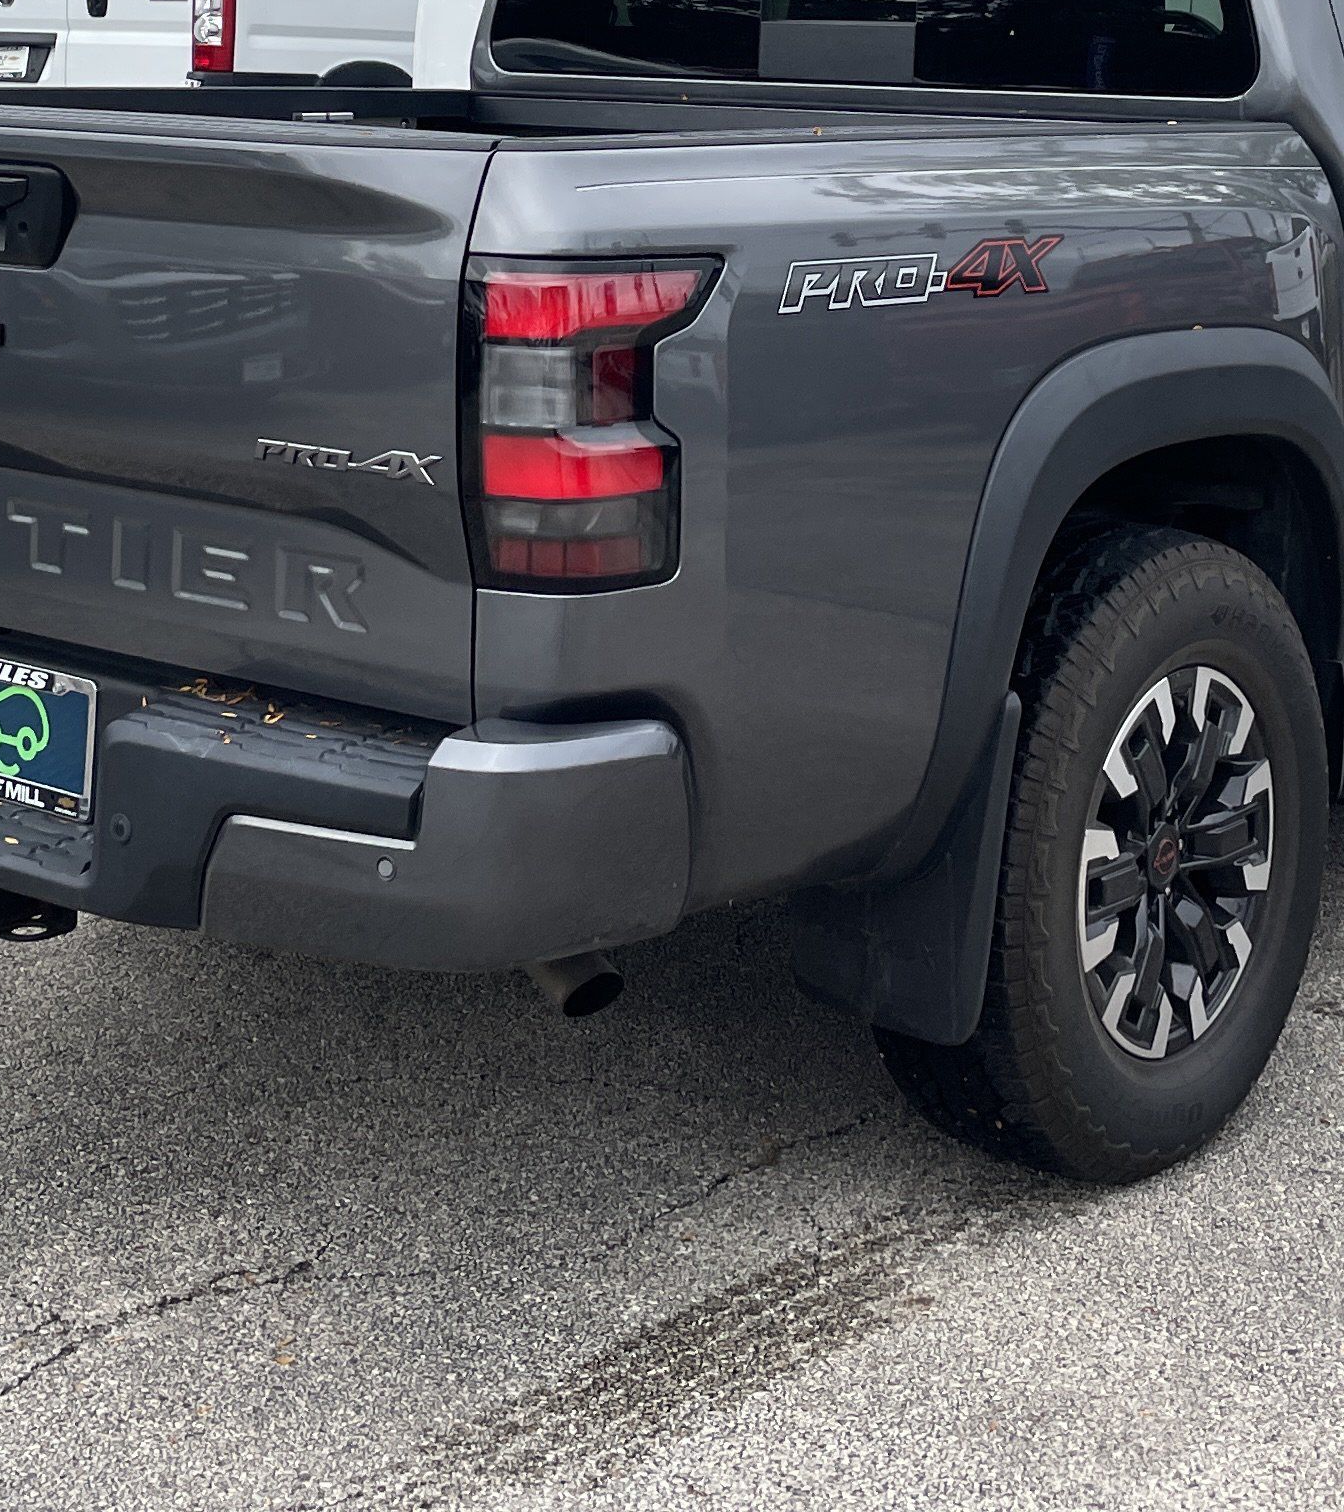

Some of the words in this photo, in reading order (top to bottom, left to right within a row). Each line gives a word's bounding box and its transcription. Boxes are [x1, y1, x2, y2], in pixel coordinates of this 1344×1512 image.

[777, 234, 1065, 316] PRO-4X
[254, 437, 443, 487] PRO-4X
[5, 782, 45, 808] MILL
